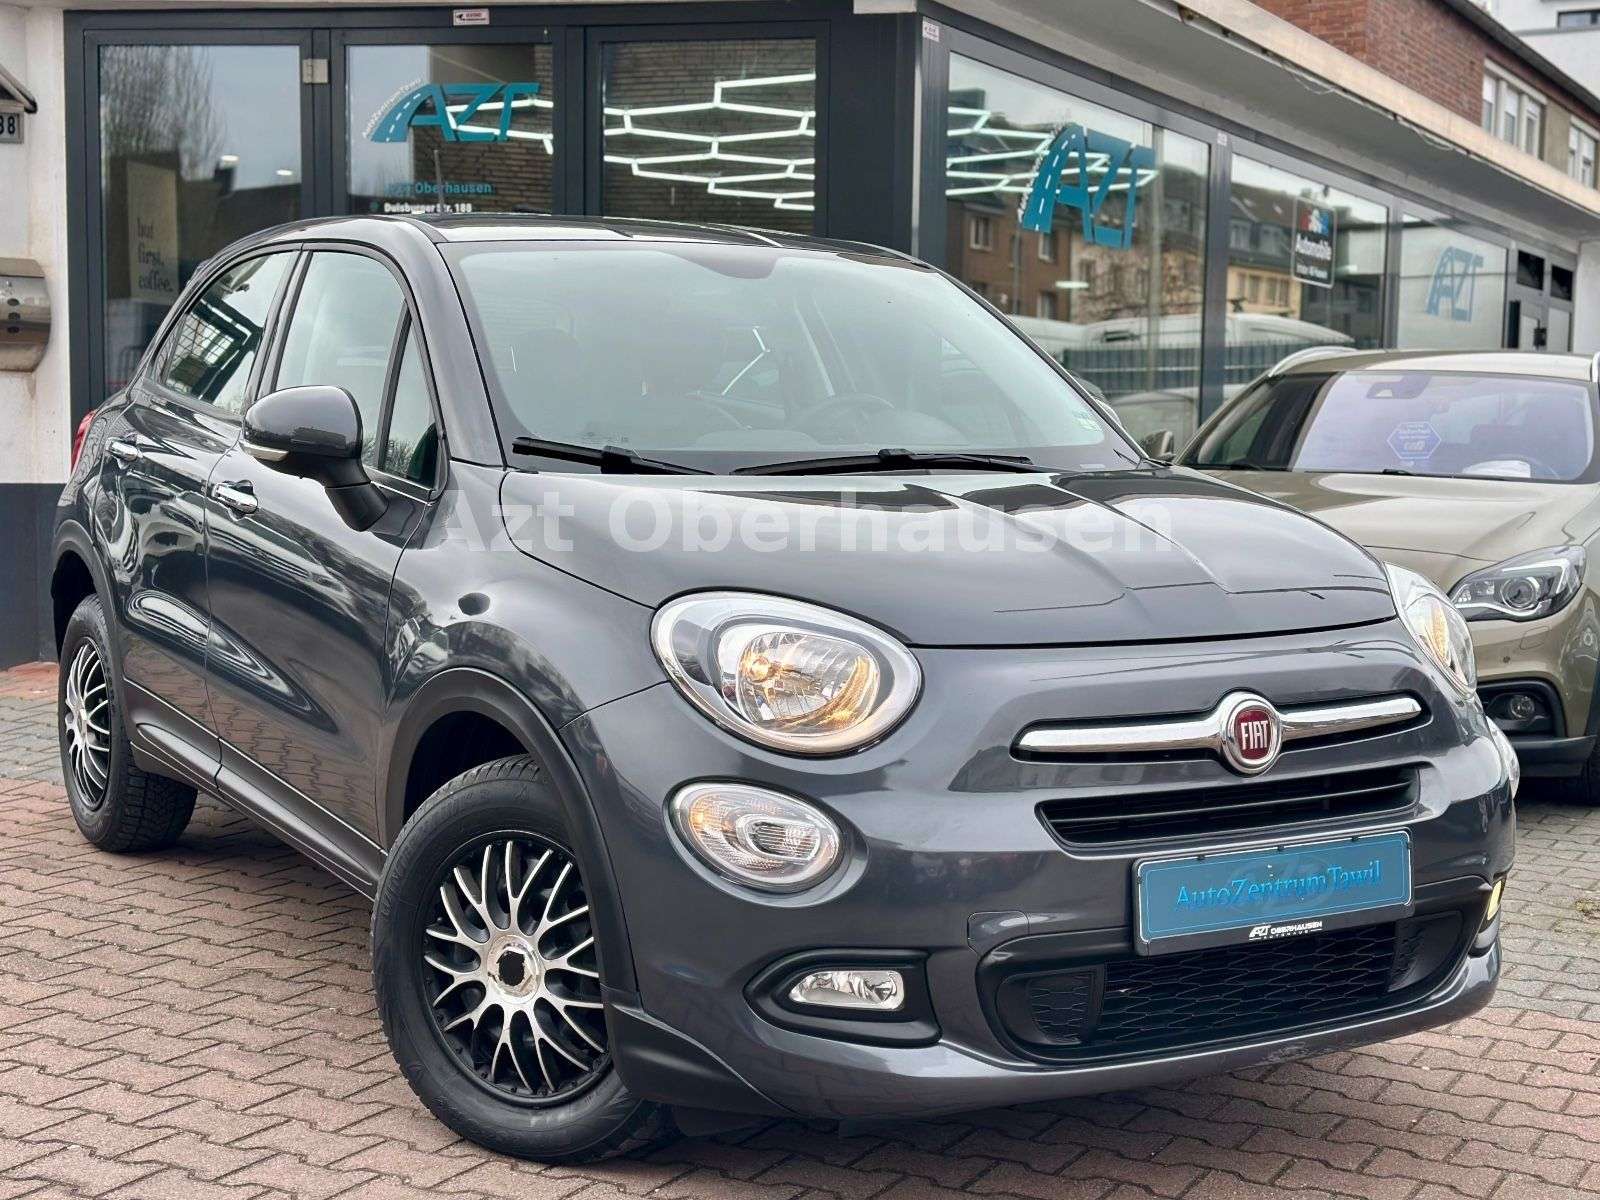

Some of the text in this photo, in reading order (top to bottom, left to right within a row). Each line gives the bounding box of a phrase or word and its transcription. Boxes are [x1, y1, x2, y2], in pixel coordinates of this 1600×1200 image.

[371, 82, 541, 143] AZT
[415, 181, 492, 194] Oberhausen
[1022, 122, 1156, 252] AZT
[1240, 720, 1269, 751] FIAT
[1270, 921, 1323, 934] OBERHAUSEN
